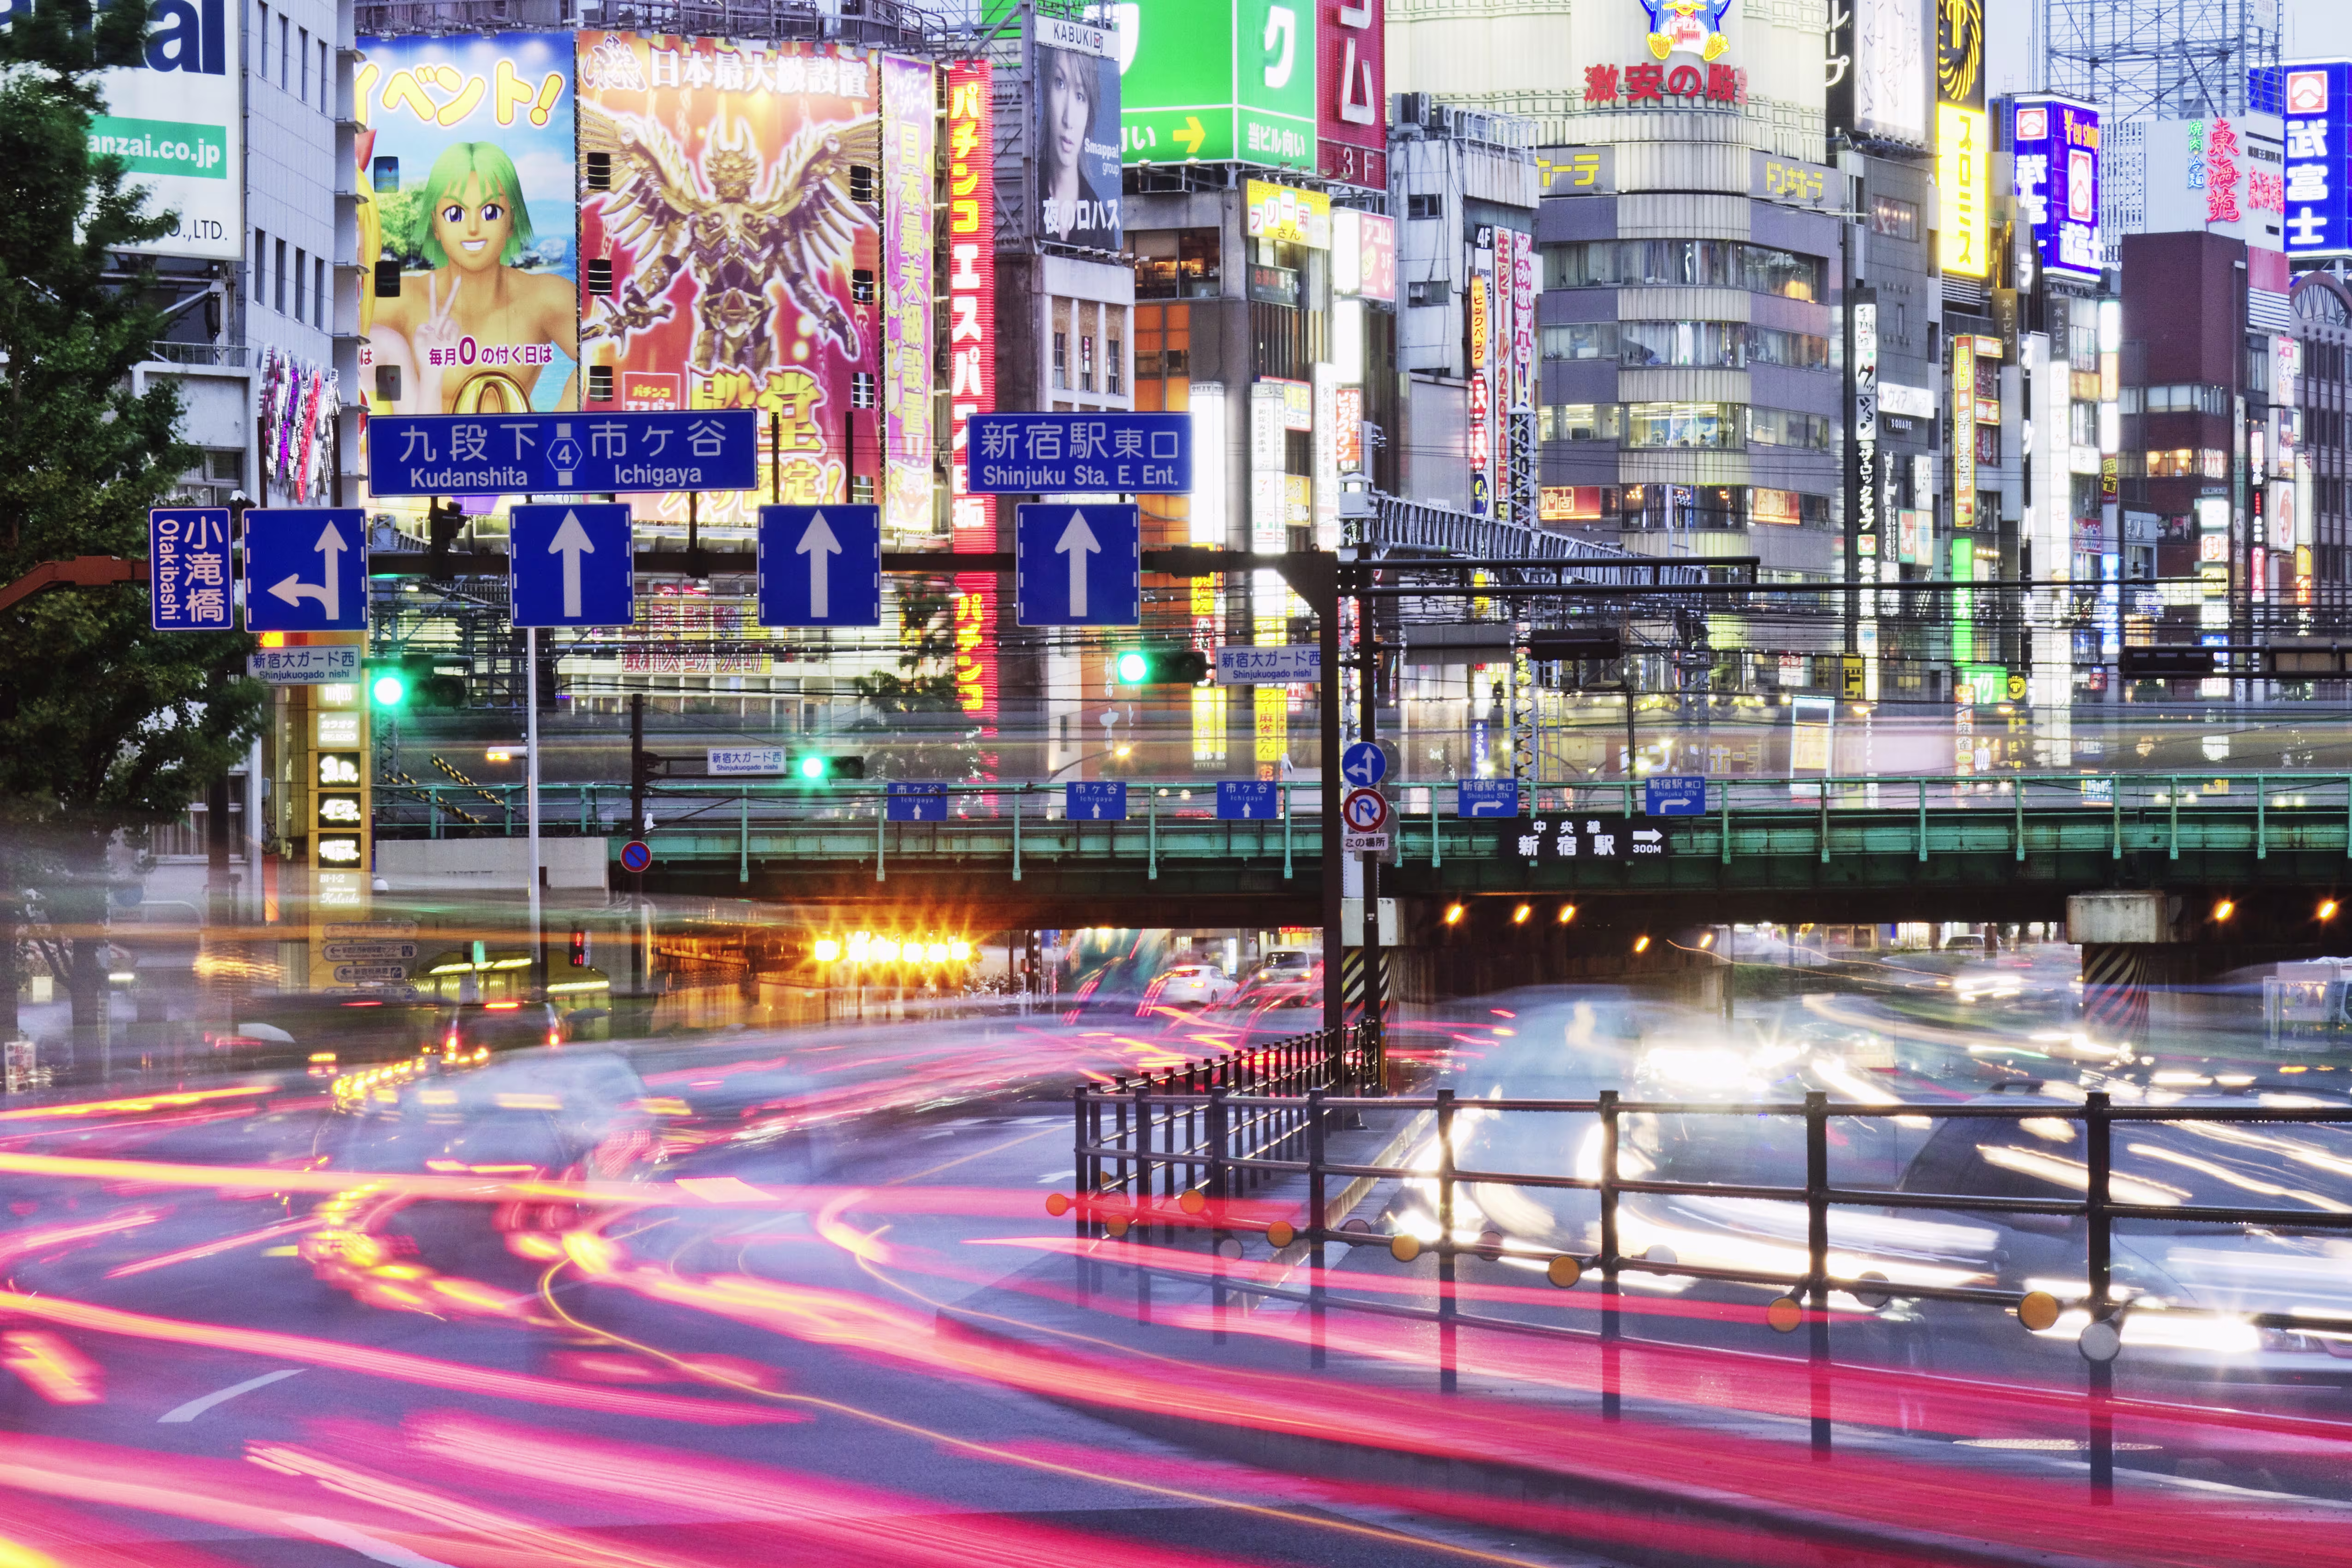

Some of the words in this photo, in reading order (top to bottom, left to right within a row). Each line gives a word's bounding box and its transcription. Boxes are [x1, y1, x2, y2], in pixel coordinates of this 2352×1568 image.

[651, 48, 870, 98] 日本最大級設置
[1583, 62, 1748, 106] 激安の殿堂
[1084, 137, 1119, 159] Smappa!
[1248, 122, 1306, 157] 当ビル向い
[1102, 161, 1119, 176] group
[2286, 119, 2328, 245] 武富士
[1043, 197, 1121, 234] 夜のロハス
[1364, 218, 1392, 245] アコム
[1477, 227, 1491, 248] 4F
[2002, 298, 2012, 345] 水上ビル
[2054, 307, 2065, 355] 水上ビル
[429, 337, 553, 366] 毎月0の付く日は
[633, 385, 671, 398] パチンコ
[1891, 418, 1912, 430] SQUARE
[399, 424, 539, 463] 九段下
[980, 422, 1179, 460] 新宿駅東口
[557, 445, 572, 464] 4
[410, 466, 528, 488] Kudanshita
[614, 463, 702, 487] Ichigaya
[983, 465, 1066, 488] Shinjuku
[1074, 465, 1109, 486] Sta.
[1118, 465, 1135, 485] E.
[1143, 465, 1179, 486] Ent.
[2103, 457, 2117, 493] 麻雀
[158, 519, 181, 620] Otakibashi
[184, 516, 225, 623] 小滝橋
[252, 651, 356, 670] 新宿大ガード西
[956, 593, 983, 710] パチンコ
[1221, 651, 1321, 670] 新宿大ガード西
[259, 670, 325, 680] Shinjukuogado
[328, 669, 350, 678] nishi
[1233, 670, 1291, 680] Shinjukuogado
[1293, 669, 1312, 677] nishi
[712, 751, 782, 764] 新宿大ガード西
[716, 764, 761, 772] Shinjukuogado
[1533, 820, 1601, 834] 中央線
[1345, 837, 1385, 848] この場所
[1518, 835, 1615, 856] 新宿駅
[1633, 844, 1662, 854] 300M
